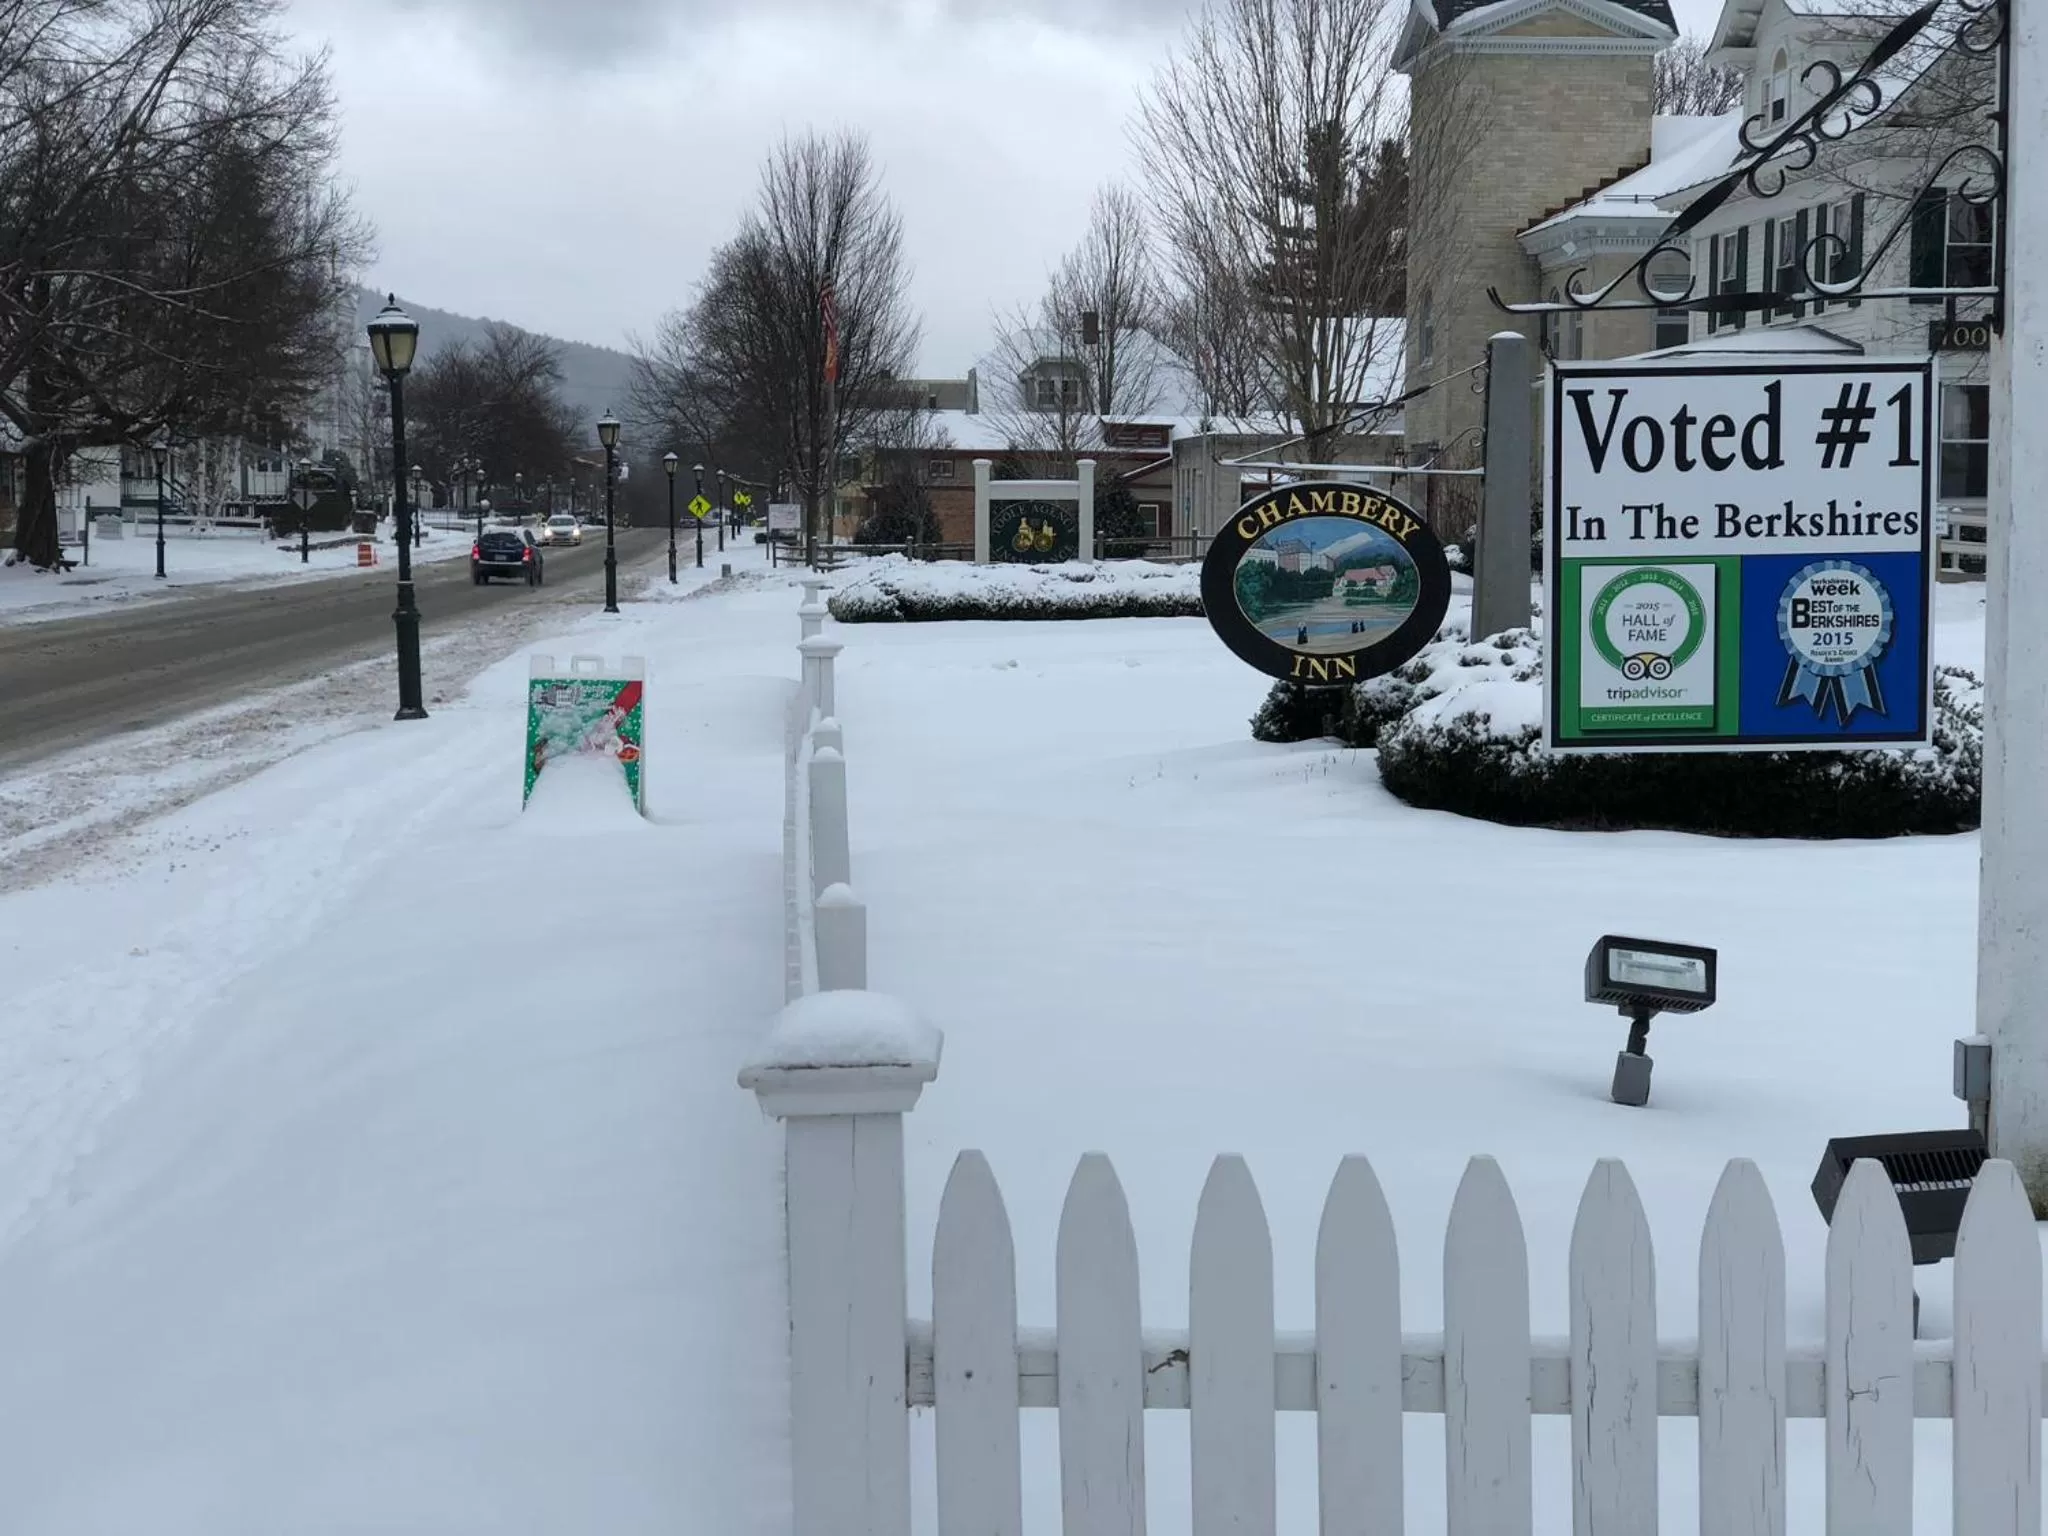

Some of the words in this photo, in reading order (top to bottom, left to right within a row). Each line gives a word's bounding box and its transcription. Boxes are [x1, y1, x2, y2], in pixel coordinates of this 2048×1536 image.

[1566, 379, 1785, 474] Voted
[1815, 381, 1921, 470] #1
[1566, 505, 1606, 541] In
[1622, 502, 1700, 540] The
[1714, 499, 1920, 538] Berkshires
[1811, 580, 1861, 596] week
[1635, 602, 1660, 611] 2015
[1846, 604, 1860, 612] THE
[1622, 614, 1660, 627] HALL
[1663, 615, 1676, 627] of
[1628, 629, 1667, 642] FAME
[1812, 632, 1854, 646] 2015
[1289, 654, 1357, 682] INN
[1606, 685, 1684, 702] tripadvisor
[1591, 712, 1642, 722] CERTIFICATE
[1651, 711, 1703, 721] EXCELLENCE
